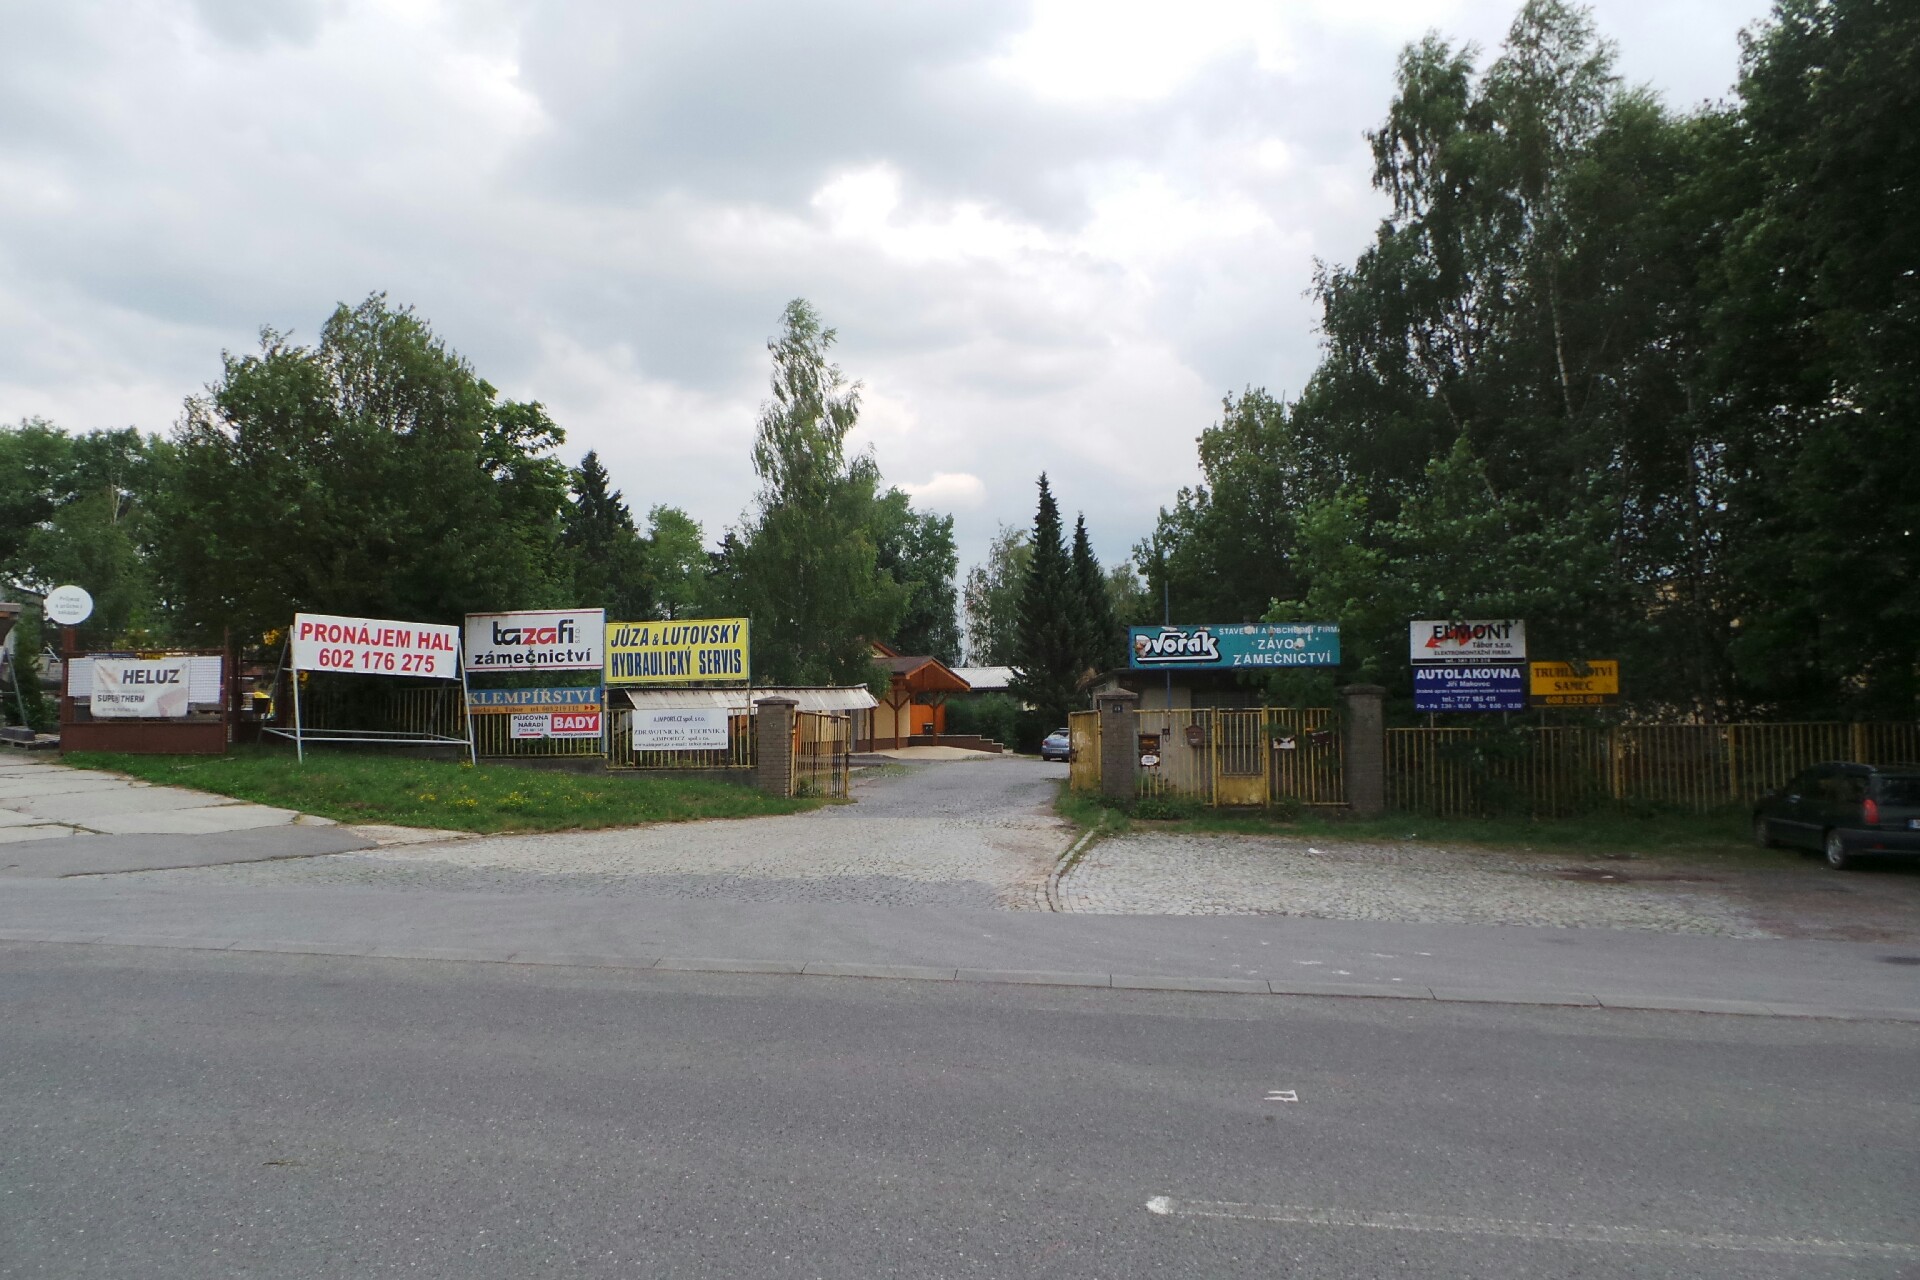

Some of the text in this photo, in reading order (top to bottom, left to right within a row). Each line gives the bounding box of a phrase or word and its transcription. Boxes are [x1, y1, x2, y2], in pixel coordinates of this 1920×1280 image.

[300, 623, 454, 651] PRONÁJEM HAL
[492, 619, 574, 645] tazafi
[611, 621, 740, 647] JŮZA & LUTOVSKÝ
[1135, 632, 1219, 656] Dvořák
[1257, 637, 1305, 650] ZÁVO
[319, 648, 435, 673] 602 176 275
[474, 648, 592, 664] zámečnictví
[611, 646, 742, 677] HYDRAULICKÝ SERVIS
[1233, 649, 1332, 666] ZÁMEČNICTVÍ
[122, 669, 180, 684] HELUZ
[1416, 668, 1521, 679] AUTOLAKOVNA
[468, 687, 596, 705] KLEMPÍŘSTVÍ
[553, 716, 597, 729] BADY
